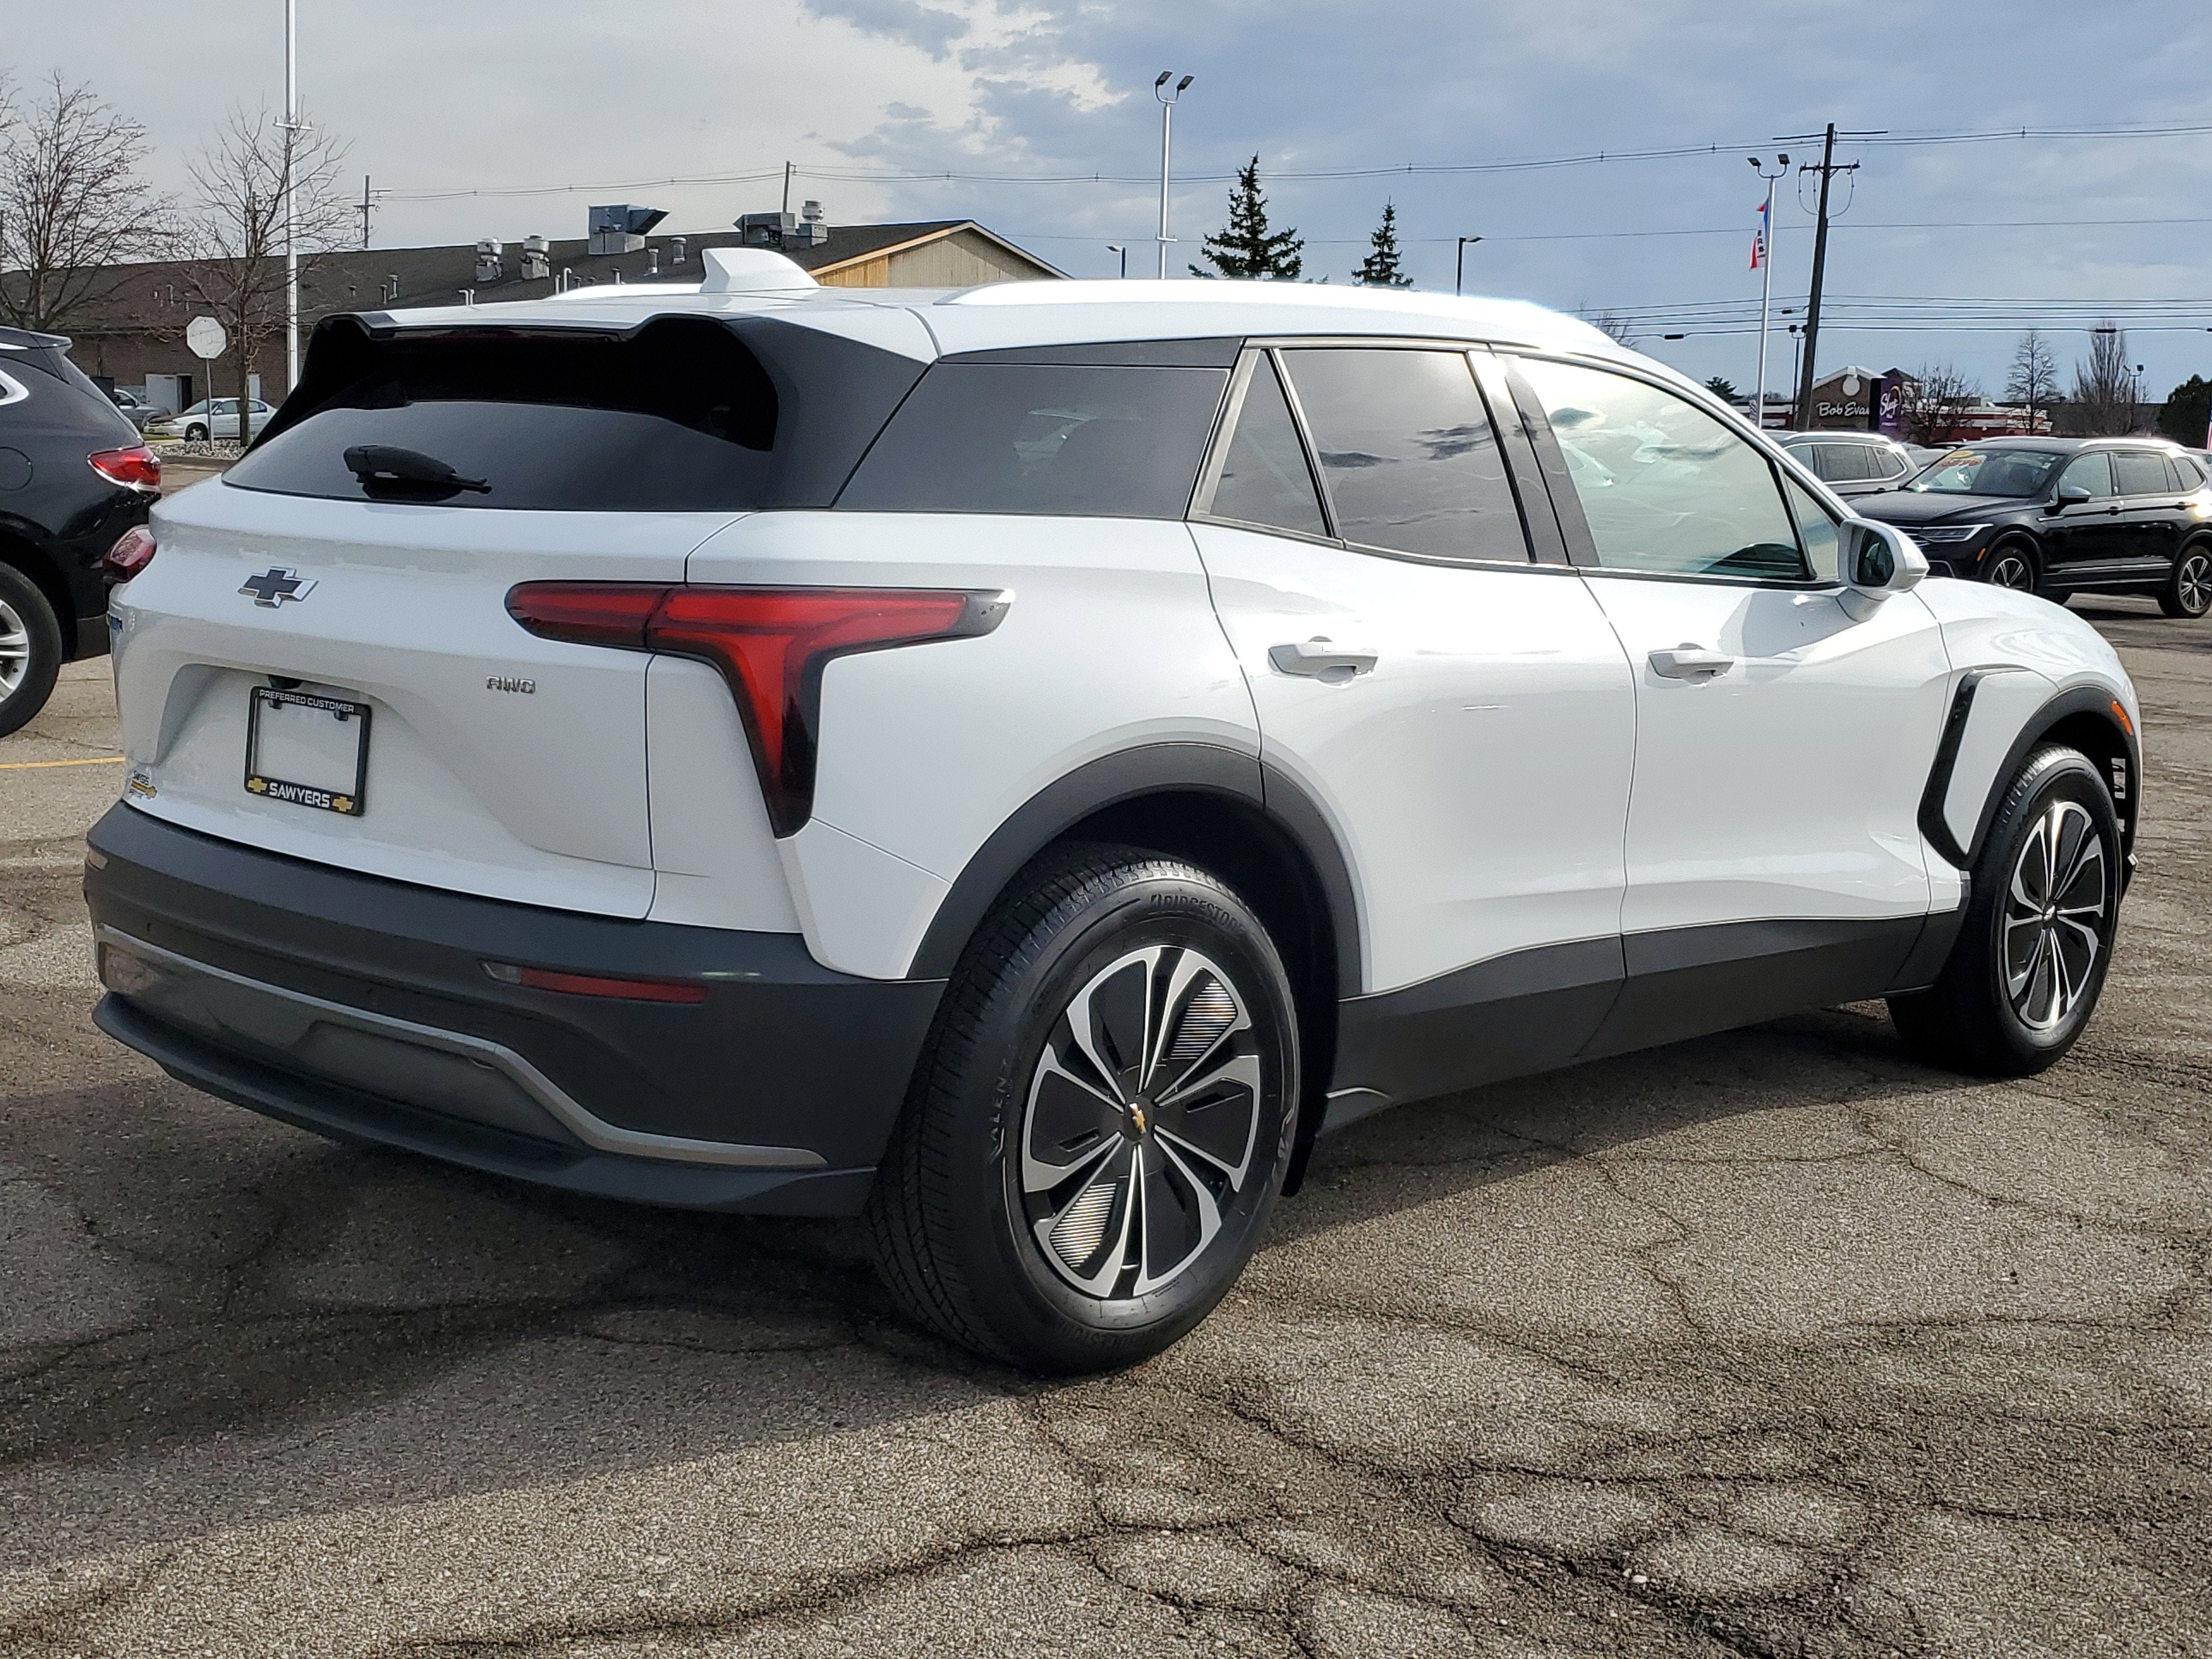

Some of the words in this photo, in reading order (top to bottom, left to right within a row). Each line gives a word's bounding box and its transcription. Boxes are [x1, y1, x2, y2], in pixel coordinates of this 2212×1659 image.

[1816, 402, 1843, 416] Bob
[486, 675, 535, 693] AWD
[259, 689, 307, 704] PREFERRED
[307, 697, 354, 713] CUSTOMER
[269, 781, 330, 808] SAWYERS
